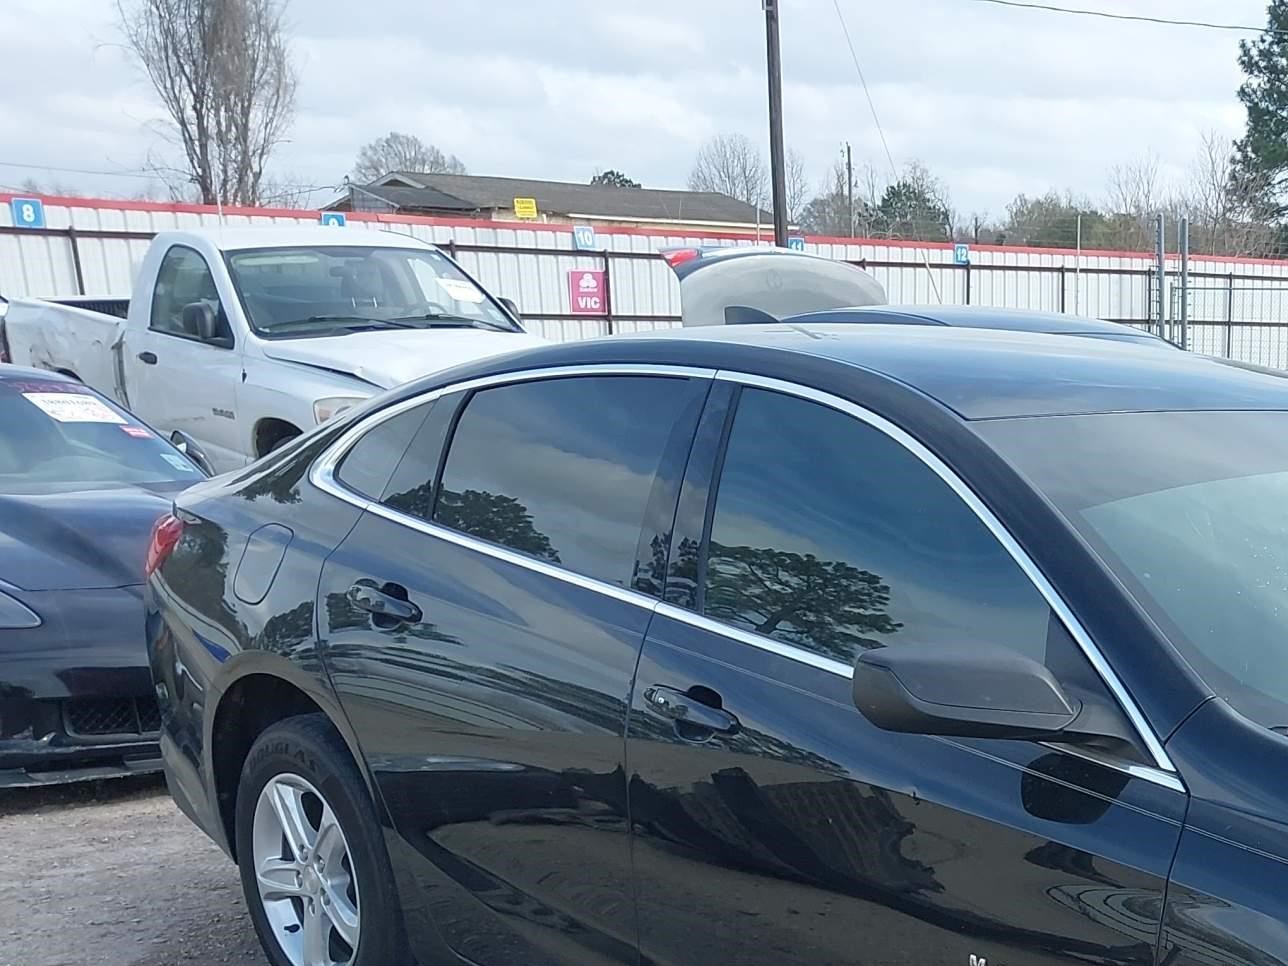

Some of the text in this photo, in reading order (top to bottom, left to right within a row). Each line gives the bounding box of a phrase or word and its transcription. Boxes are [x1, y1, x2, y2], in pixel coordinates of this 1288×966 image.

[22, 204, 36, 223] 8
[579, 231, 593, 246] 10
[957, 248, 967, 261] 12
[578, 297, 600, 309] VIC
